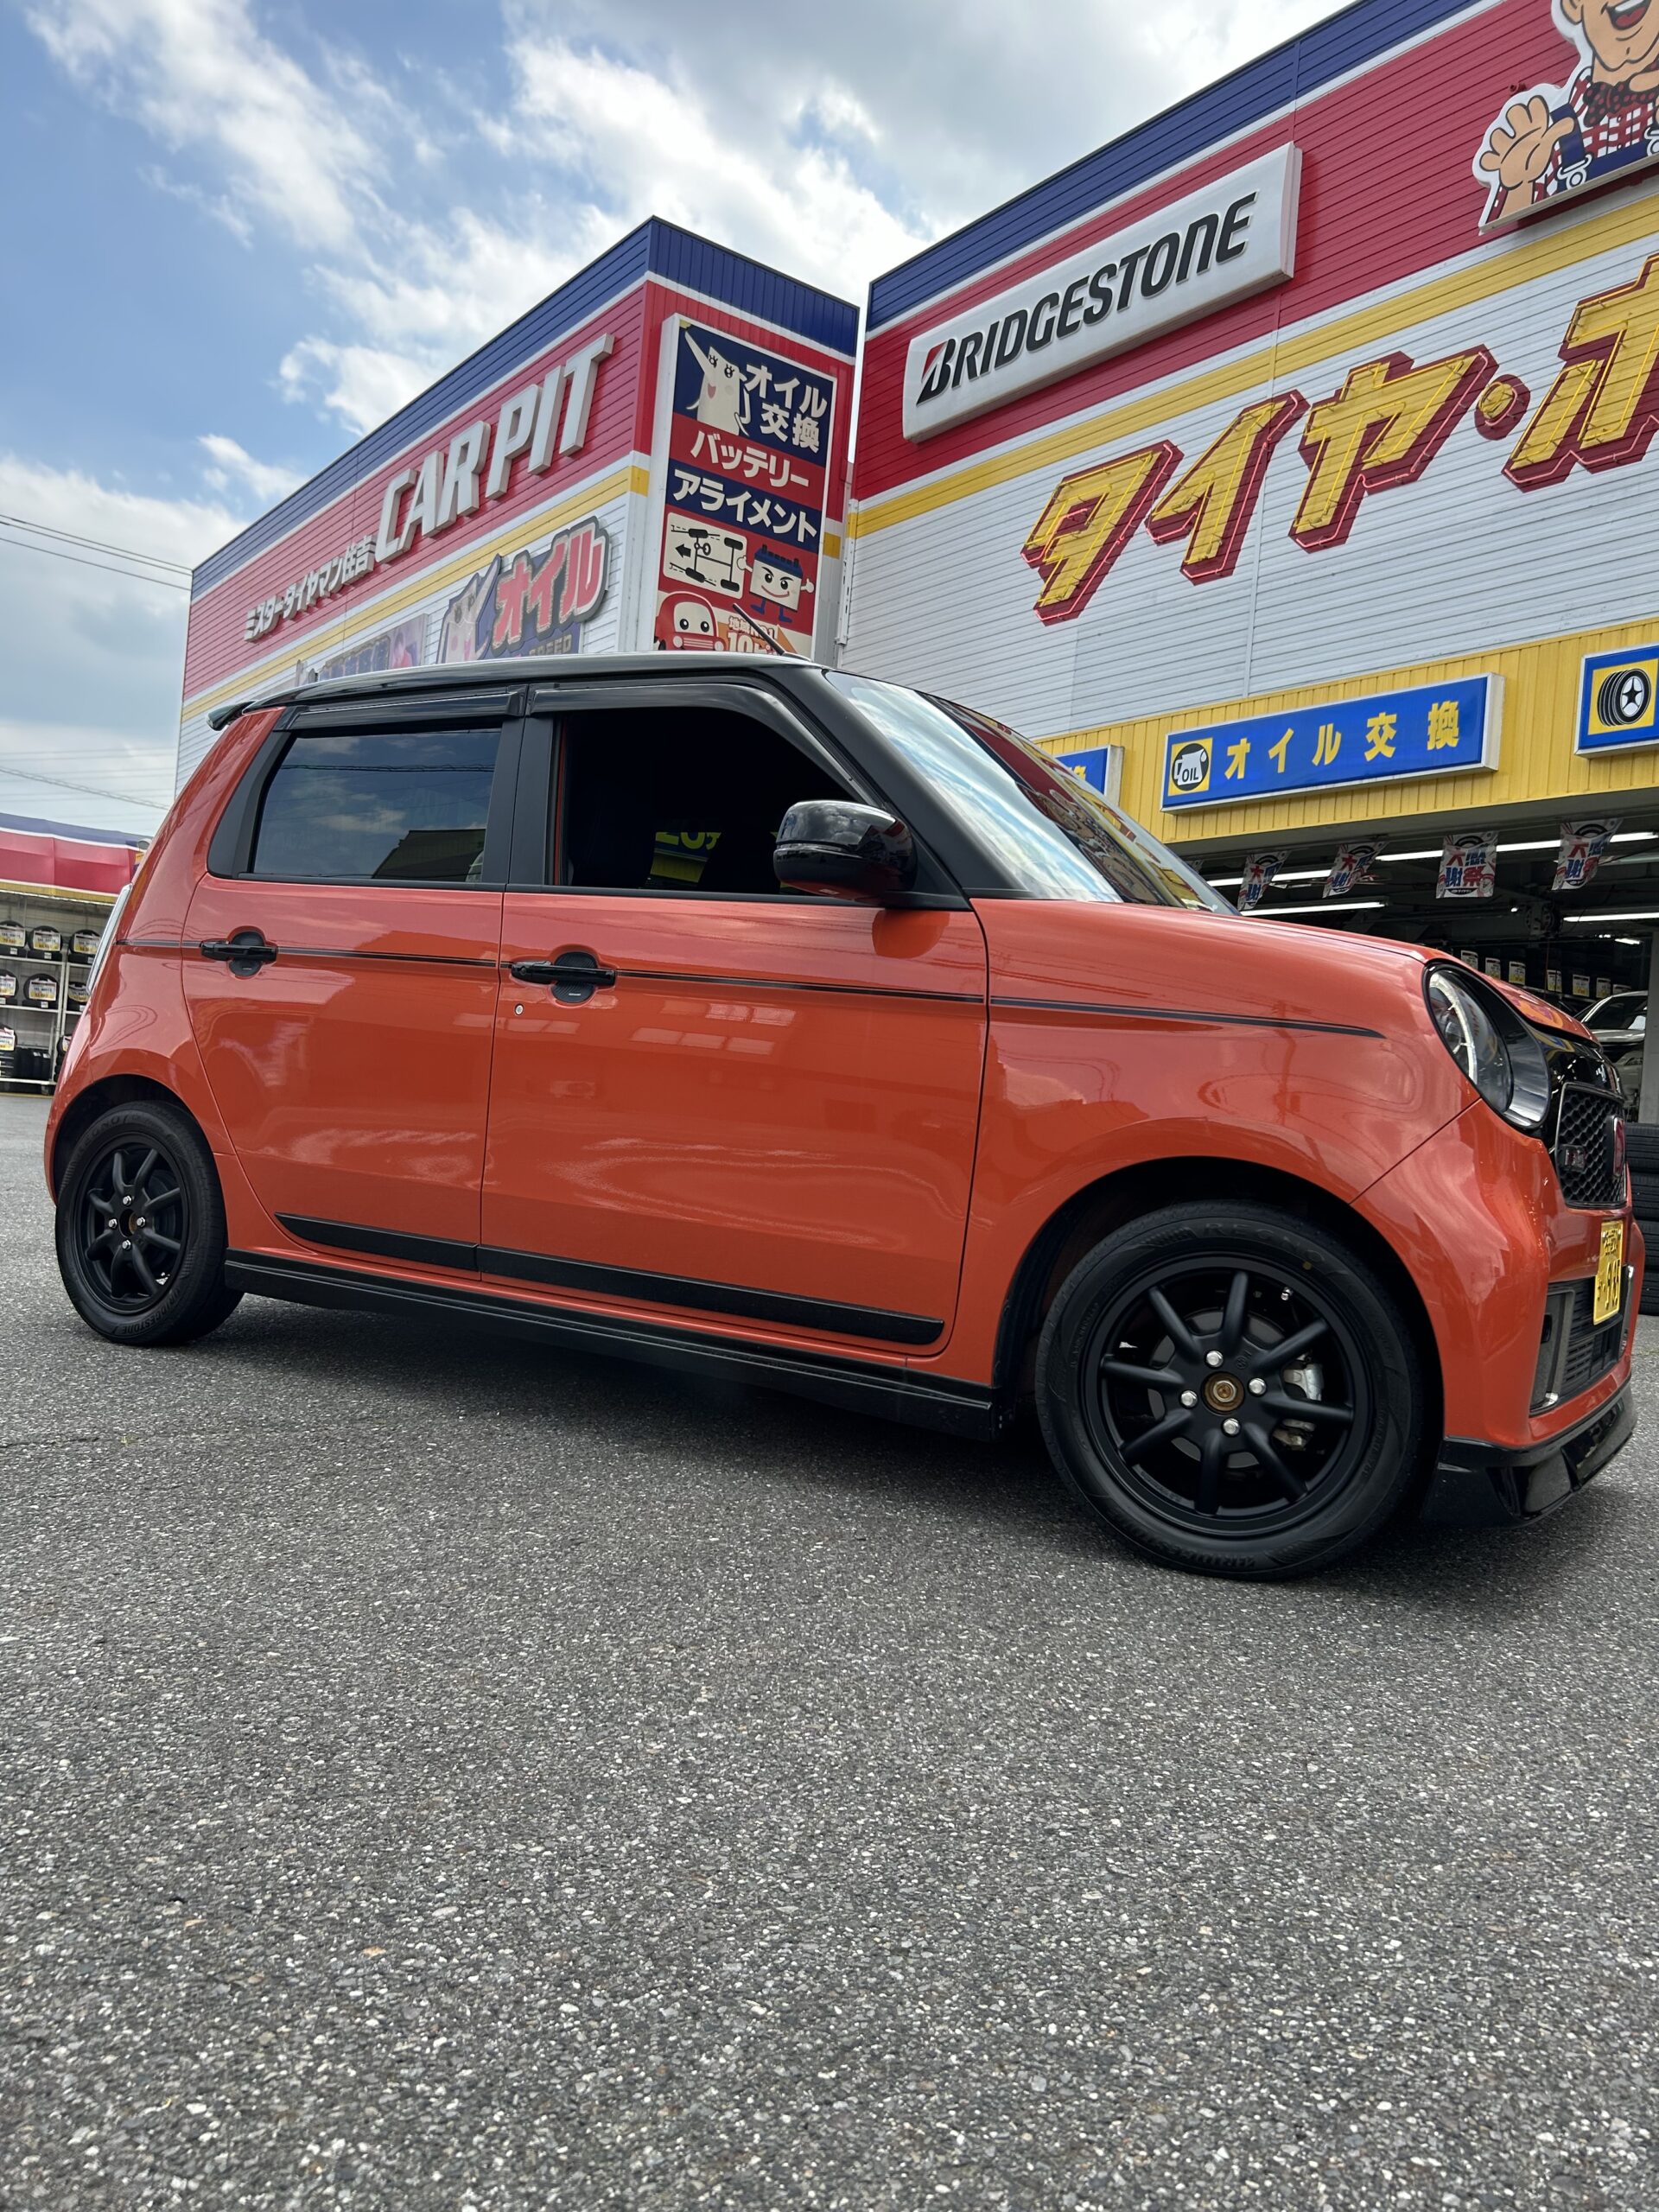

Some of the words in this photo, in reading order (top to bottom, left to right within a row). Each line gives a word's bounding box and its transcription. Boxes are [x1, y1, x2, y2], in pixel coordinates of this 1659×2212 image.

[915, 191, 1259, 407] BRIDGESTONE
[745, 363, 827, 418] オイル
[690, 430, 810, 489] バッテリー
[760, 404, 820, 454] 交換
[672, 468, 817, 543] アライメント
[492, 525, 607, 650] オイル
[1224, 700, 1460, 779] オイル交換
[1181, 767, 1199, 783] OIL
